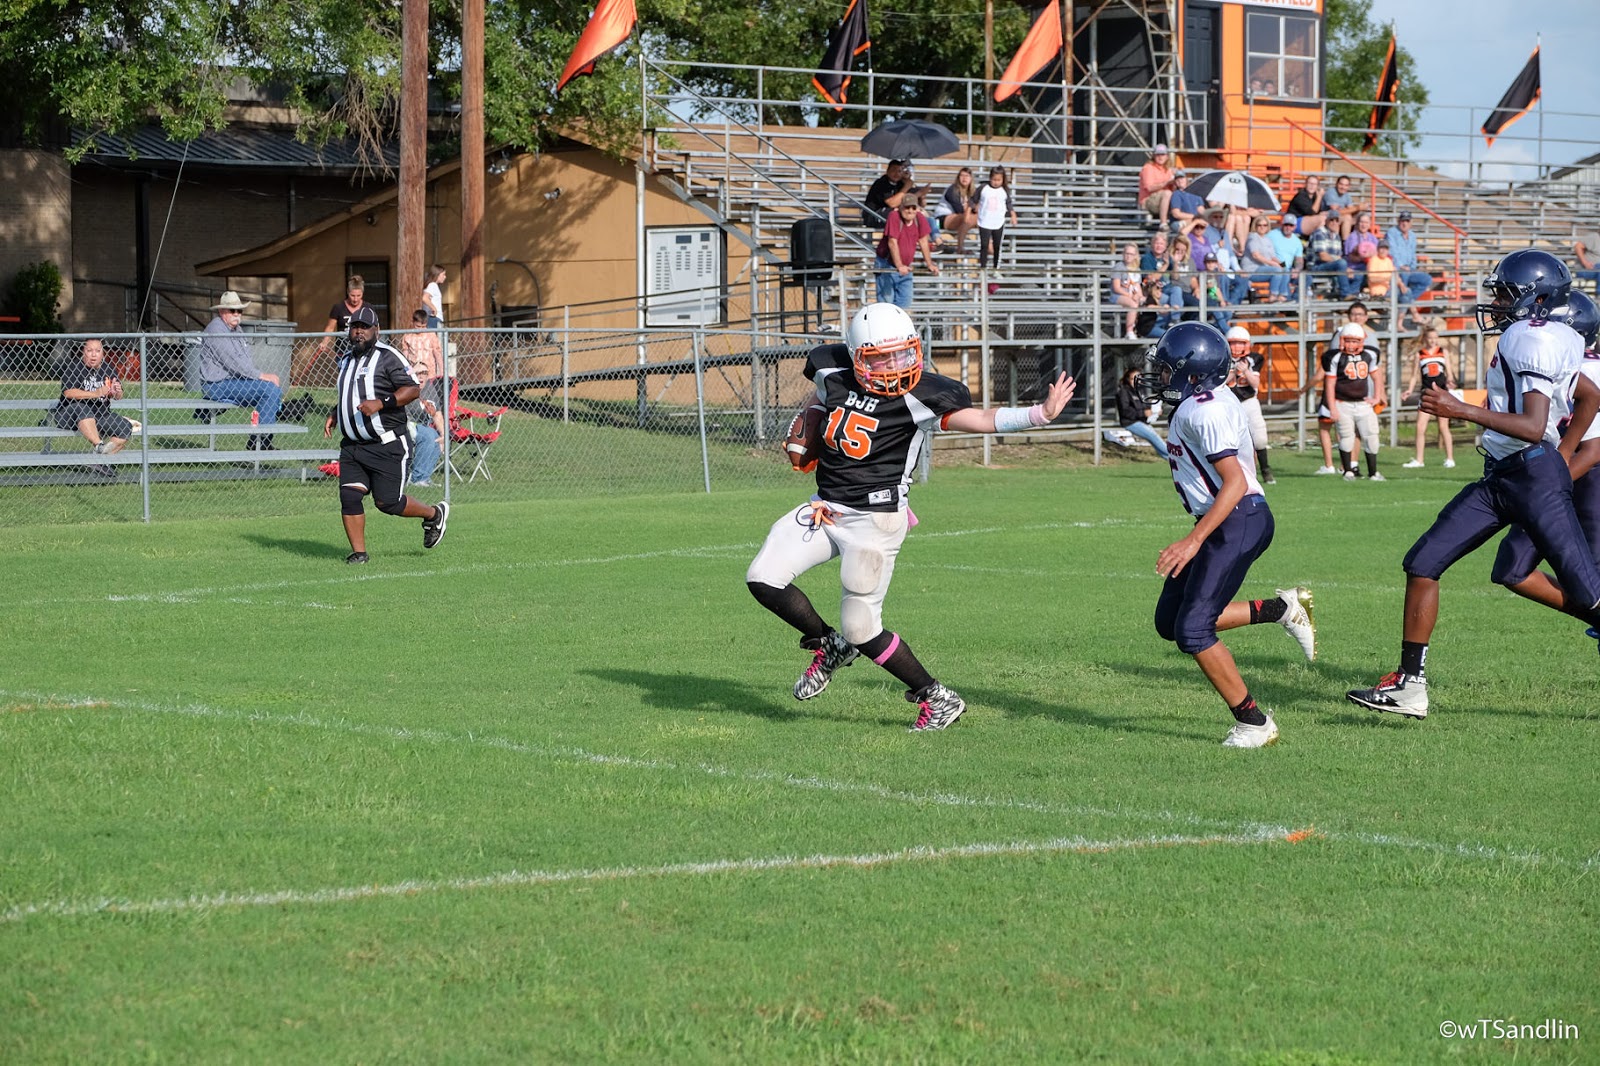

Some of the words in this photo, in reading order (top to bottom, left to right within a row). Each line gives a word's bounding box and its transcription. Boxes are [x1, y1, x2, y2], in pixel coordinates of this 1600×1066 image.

[1344, 361, 1368, 379] 48
[845, 390, 880, 413] BJH
[822, 406, 880, 460] 15
